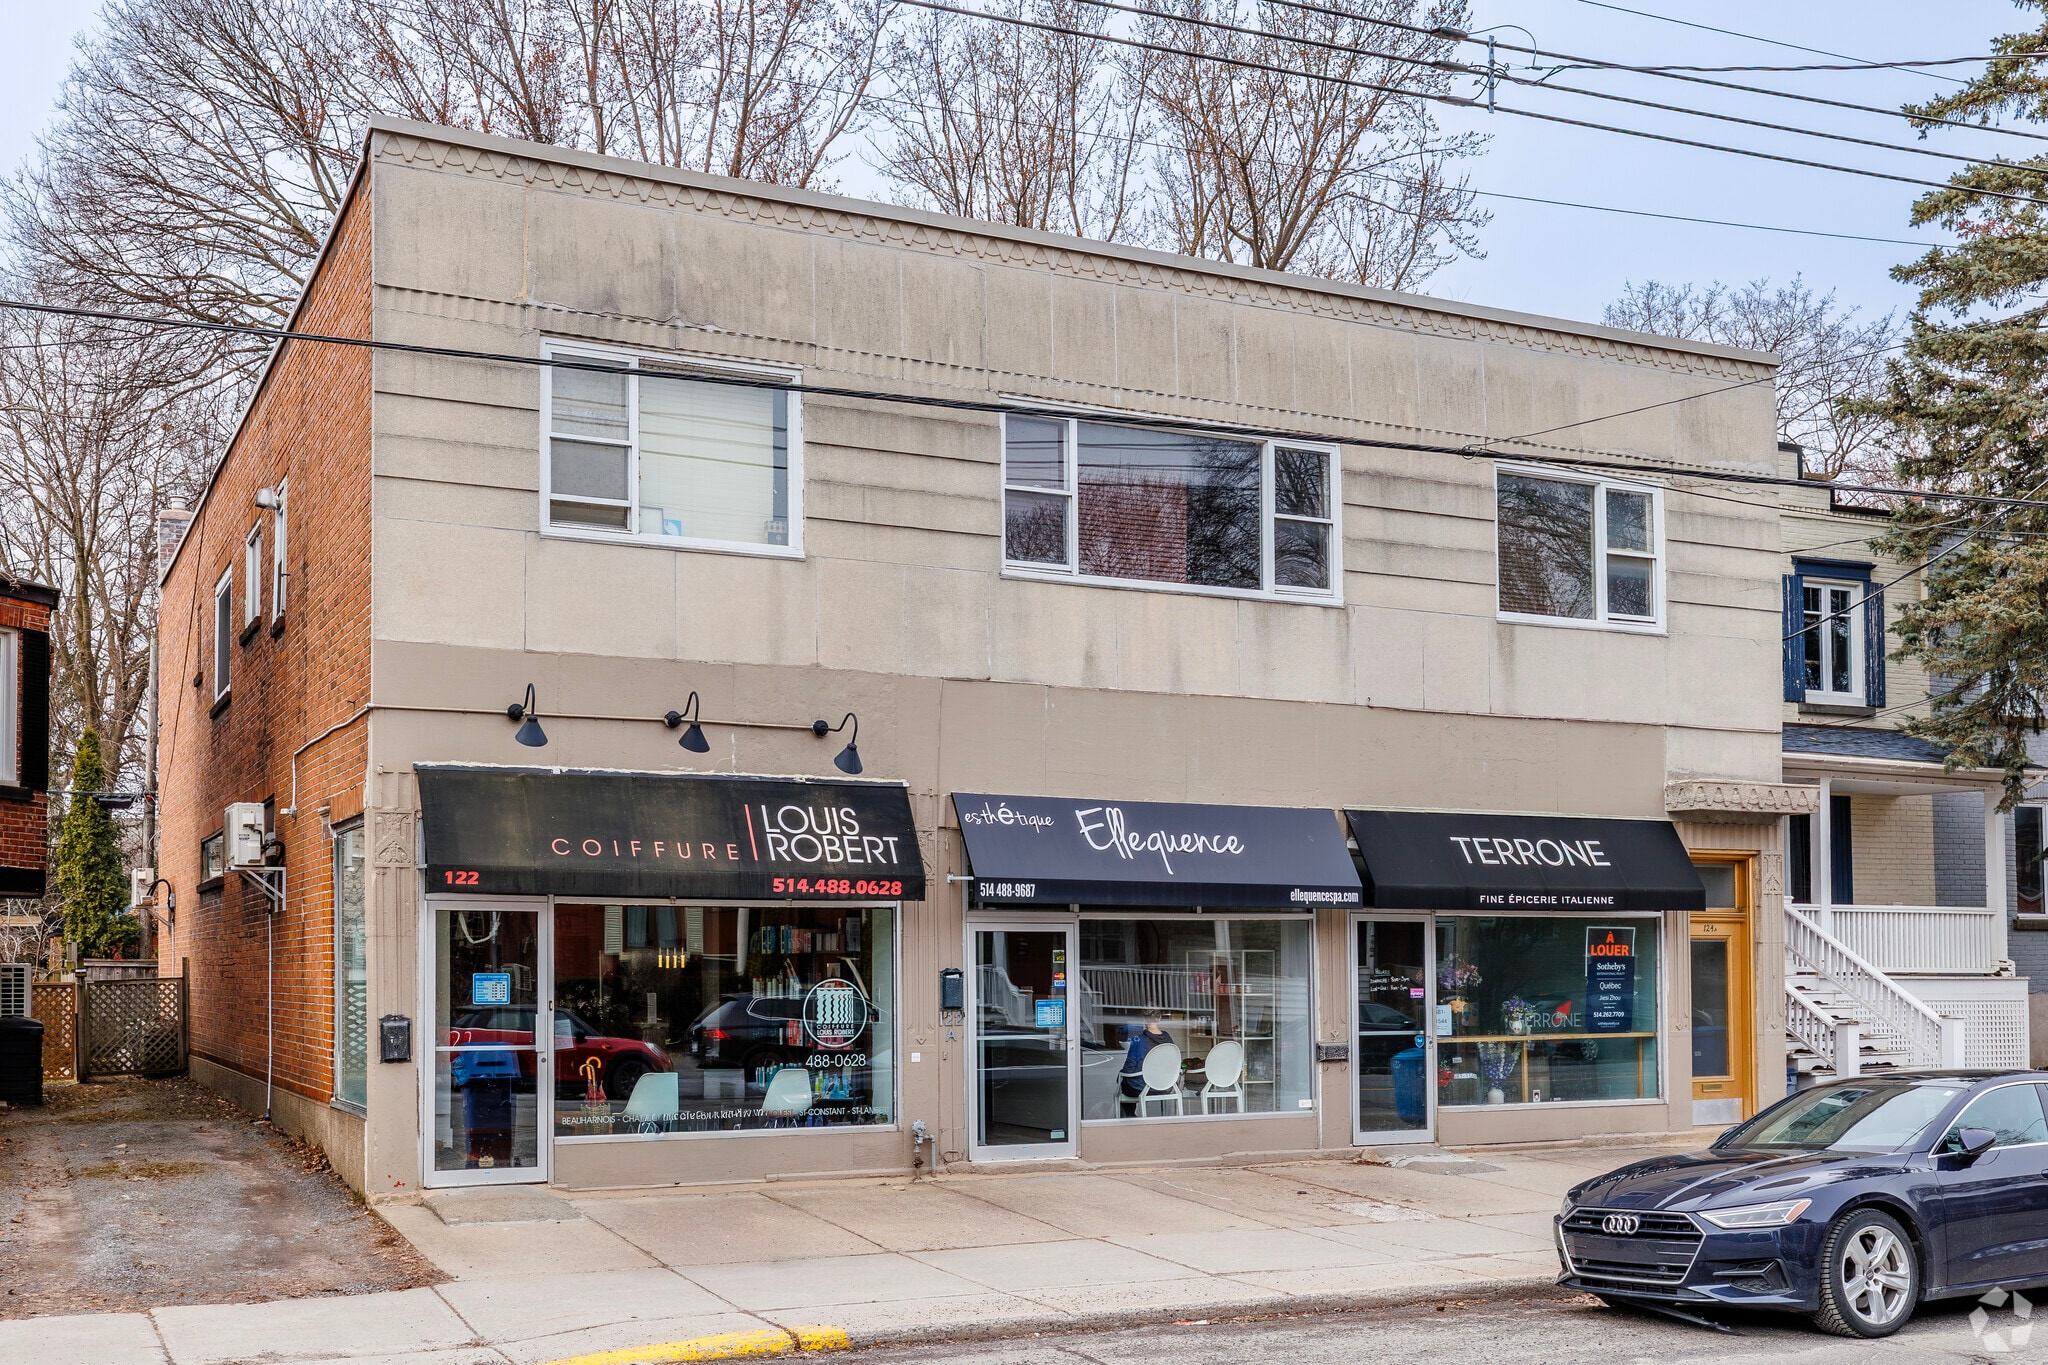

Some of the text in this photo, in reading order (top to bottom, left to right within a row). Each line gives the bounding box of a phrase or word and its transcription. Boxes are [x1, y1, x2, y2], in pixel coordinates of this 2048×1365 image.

[761, 804, 860, 835] LOUIS
[964, 802, 1055, 833] esthétique
[551, 837, 740, 861] COIFFURE
[1075, 807, 1245, 875] Ellequence
[769, 834, 900, 865] ROBERT
[1449, 836, 1612, 867] TERRONE
[444, 870, 480, 885] 122
[772, 877, 903, 896] 514.488.0628
[979, 882, 1036, 898] 514 488-9687
[1290, 888, 1359, 904] ellequencespa.com
[1479, 893, 1615, 905] FINE ÉPICERIE ITALIENNE
[1605, 930, 1615, 943] À
[1590, 944, 1629, 957] LOUER
[1596, 962, 1626, 971] Sotheby's
[1599, 981, 1622, 991] Québec
[938, 1011, 964, 1027] 122
[945, 1028, 957, 1042] A
[805, 1053, 867, 1067] 488-0628
